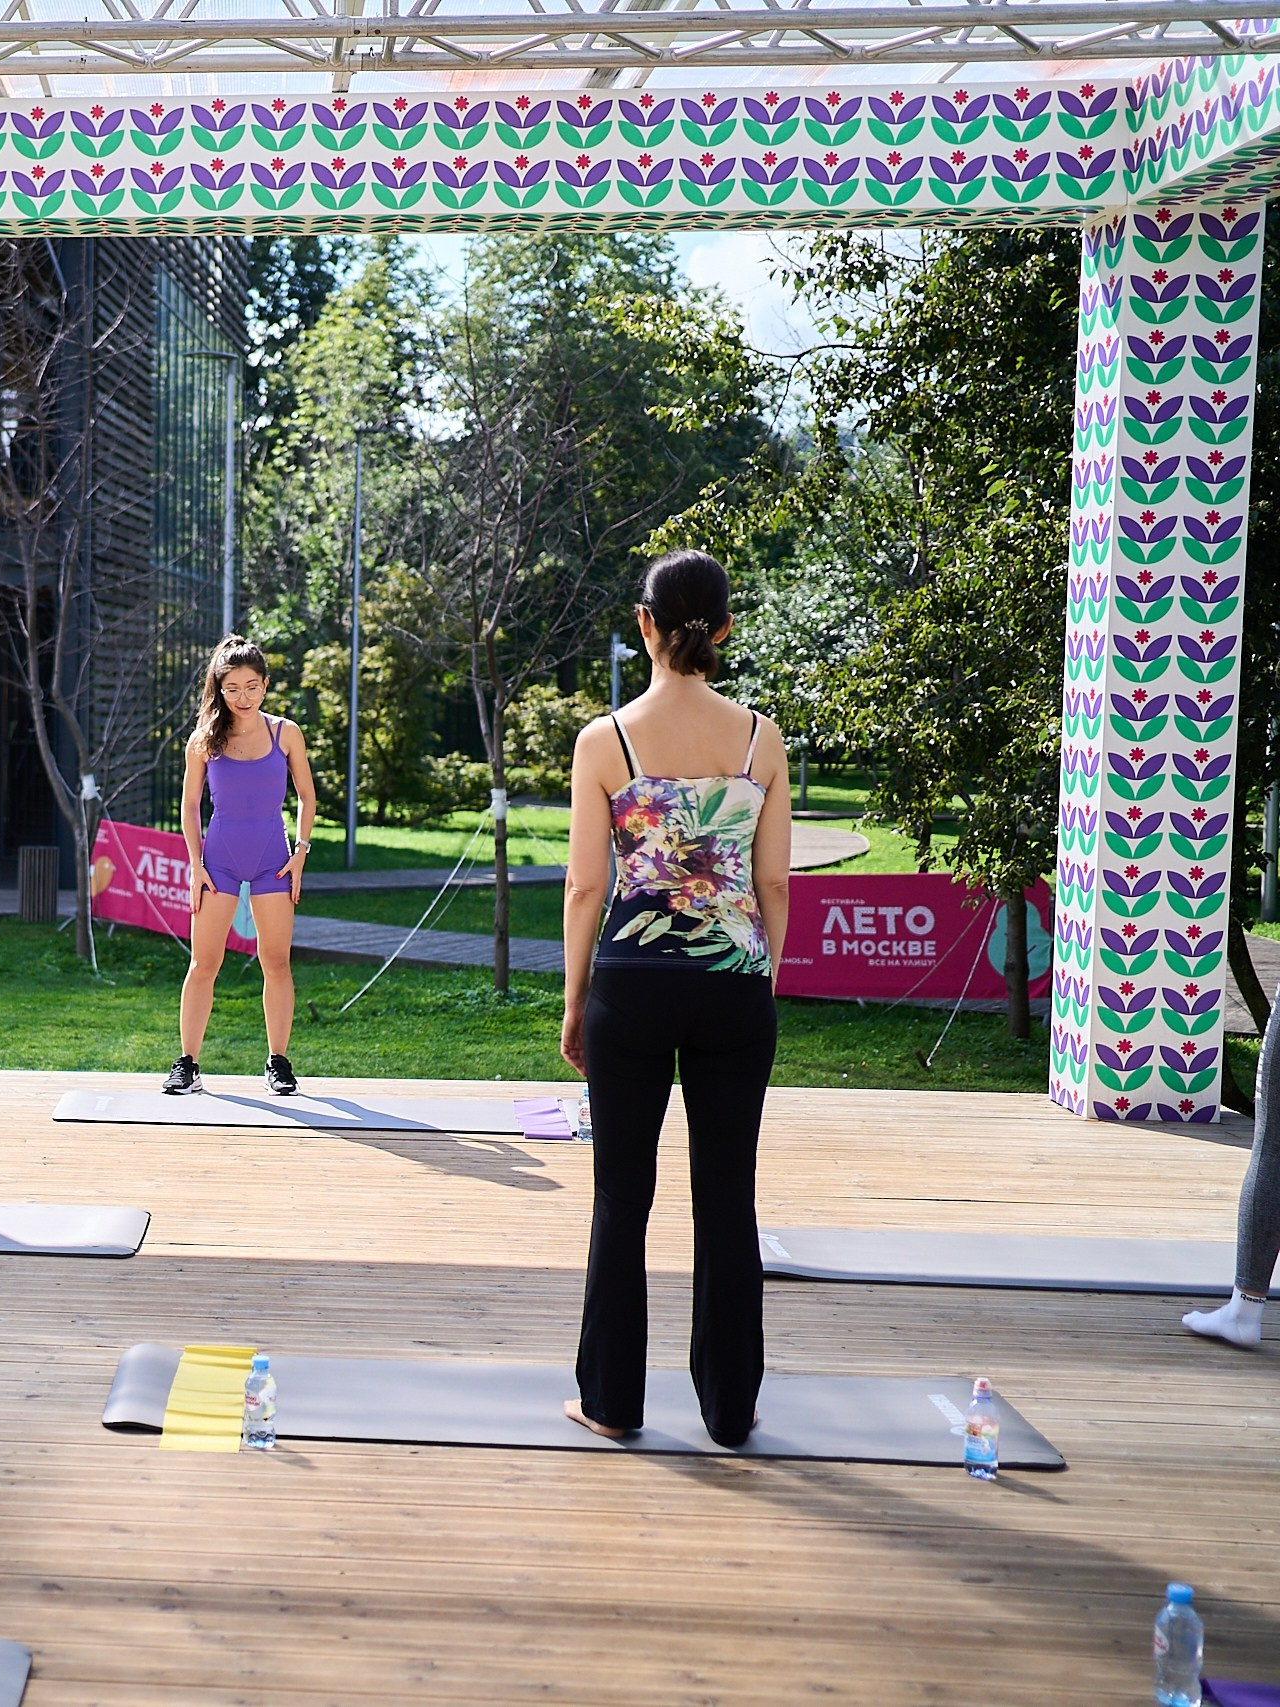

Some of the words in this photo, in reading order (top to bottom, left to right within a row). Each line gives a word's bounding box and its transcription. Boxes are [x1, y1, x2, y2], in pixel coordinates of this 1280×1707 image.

[822, 905, 936, 936] ЛЕТО
[822, 939, 837, 956] В
[842, 939, 937, 956] МОСКВЕ
[869, 958, 886, 967] ВСЕ
[887, 958, 901, 967] НА
[1240, 1293, 1266, 1304] Reeb
